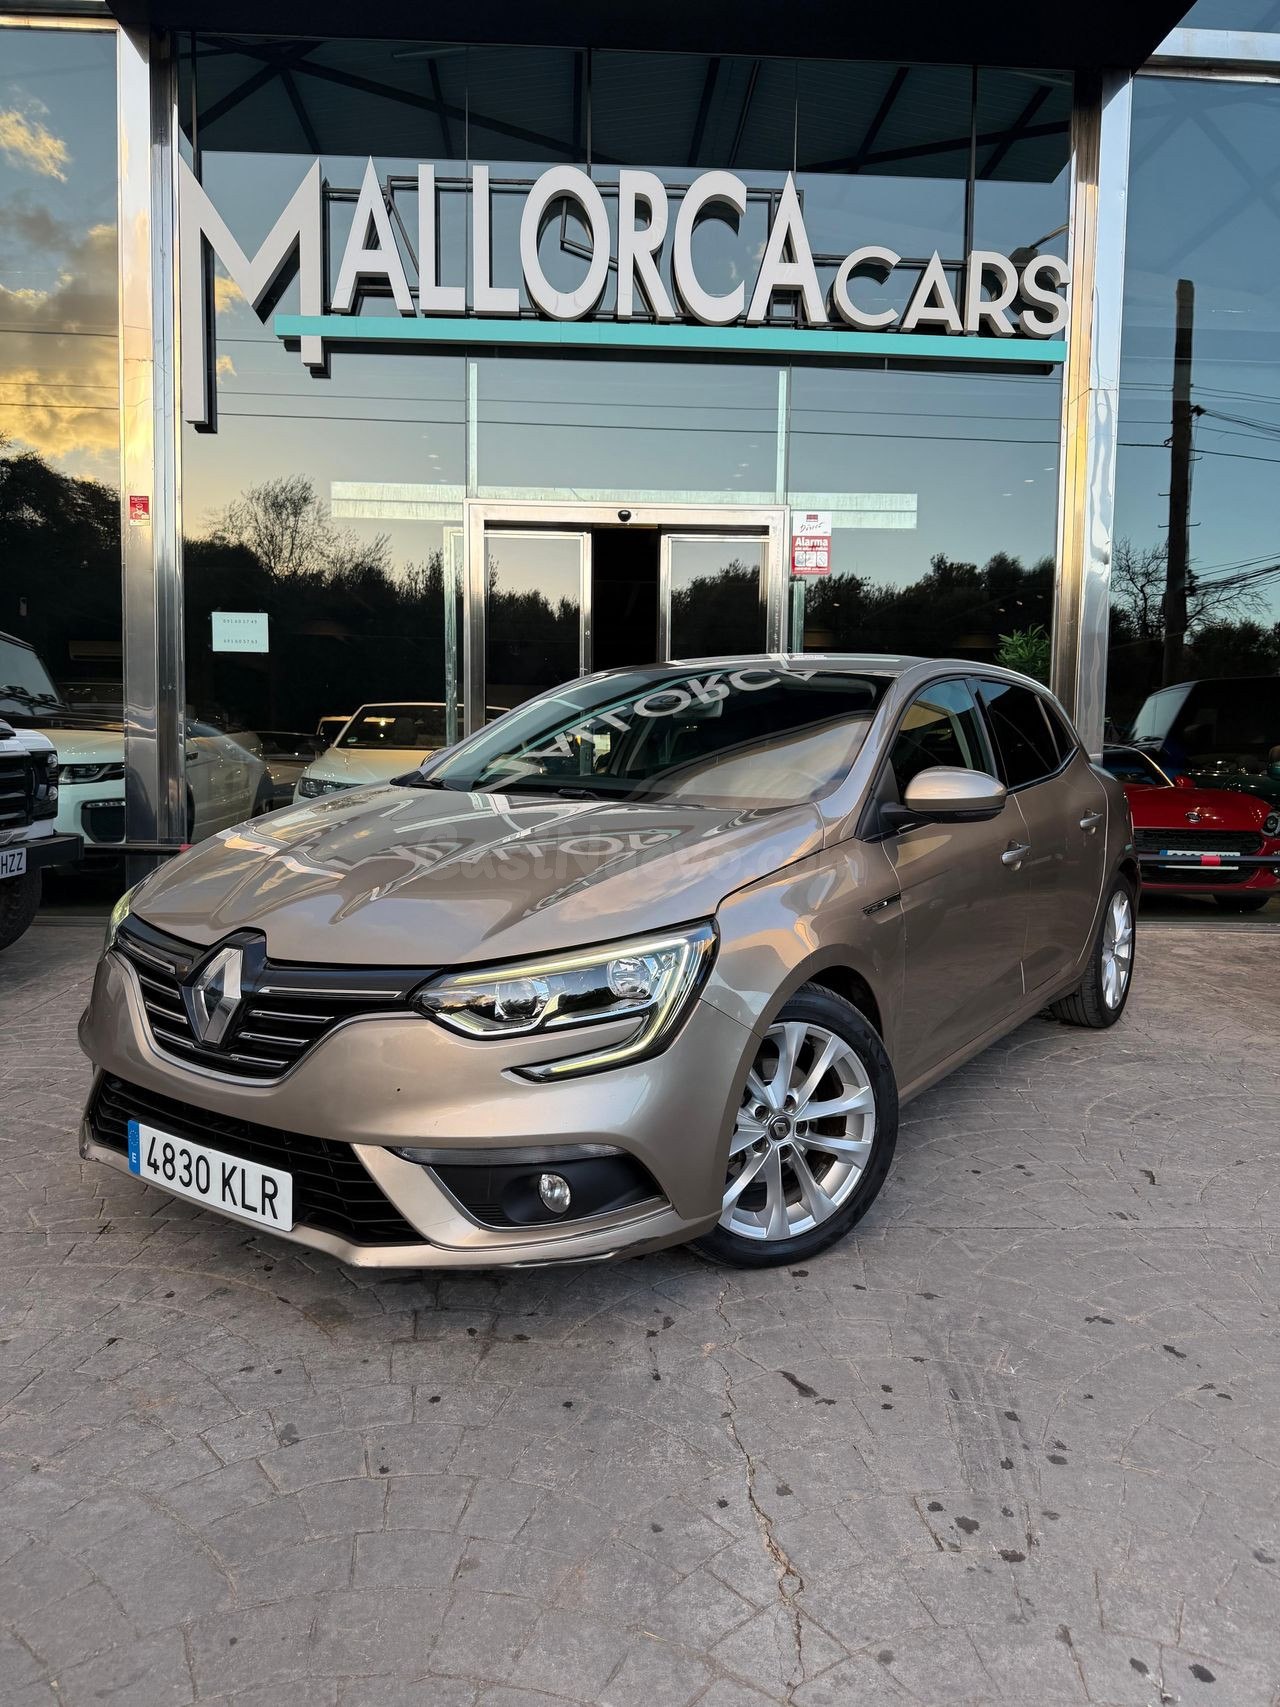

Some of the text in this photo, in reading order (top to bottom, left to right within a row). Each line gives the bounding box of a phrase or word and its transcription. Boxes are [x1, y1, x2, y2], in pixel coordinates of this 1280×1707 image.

[179, 155, 1070, 423] MALLORCA CARS
[795, 537, 828, 547] Alarma
[0, 852, 23, 875] HZZ
[131, 1152, 137, 1164] E
[147, 1136, 279, 1220] 4830 KLR
